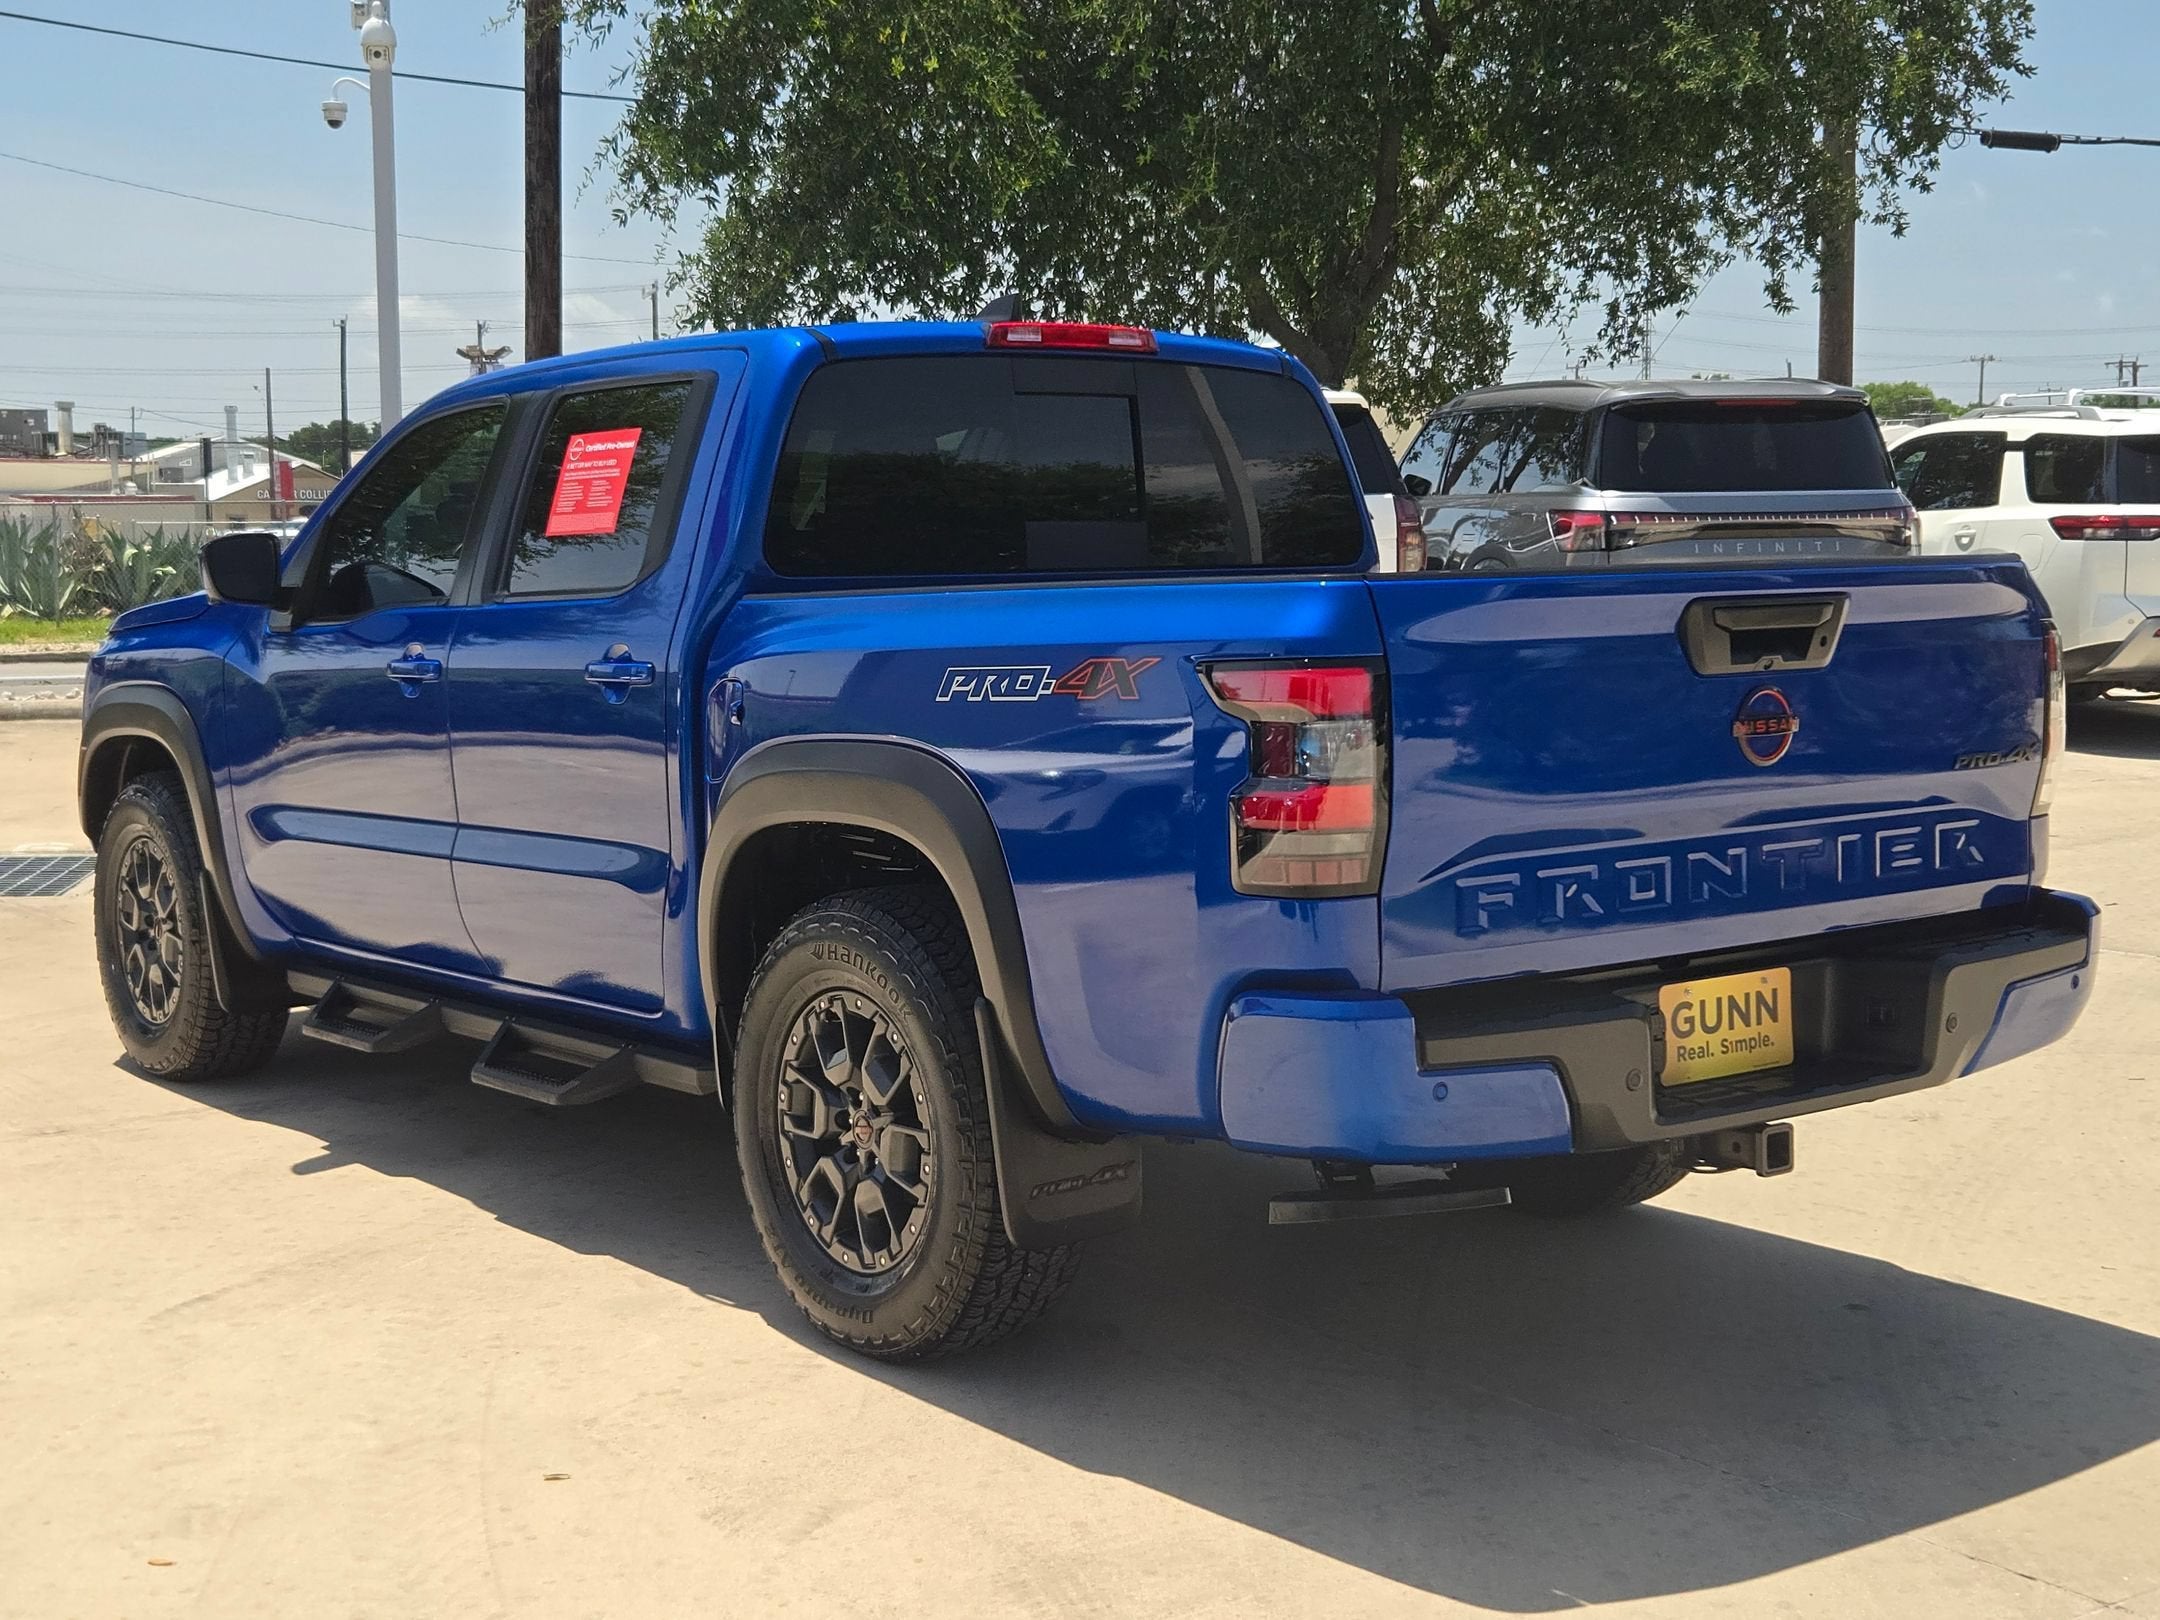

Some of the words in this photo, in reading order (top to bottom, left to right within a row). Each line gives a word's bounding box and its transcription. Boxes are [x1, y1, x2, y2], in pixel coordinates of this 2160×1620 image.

[1695, 541, 1839, 553] INFINITI
[1455, 819, 1985, 937] FRONTIER
[1671, 988, 1779, 1039] GUNN
[1677, 1041, 1714, 1062] Real.
